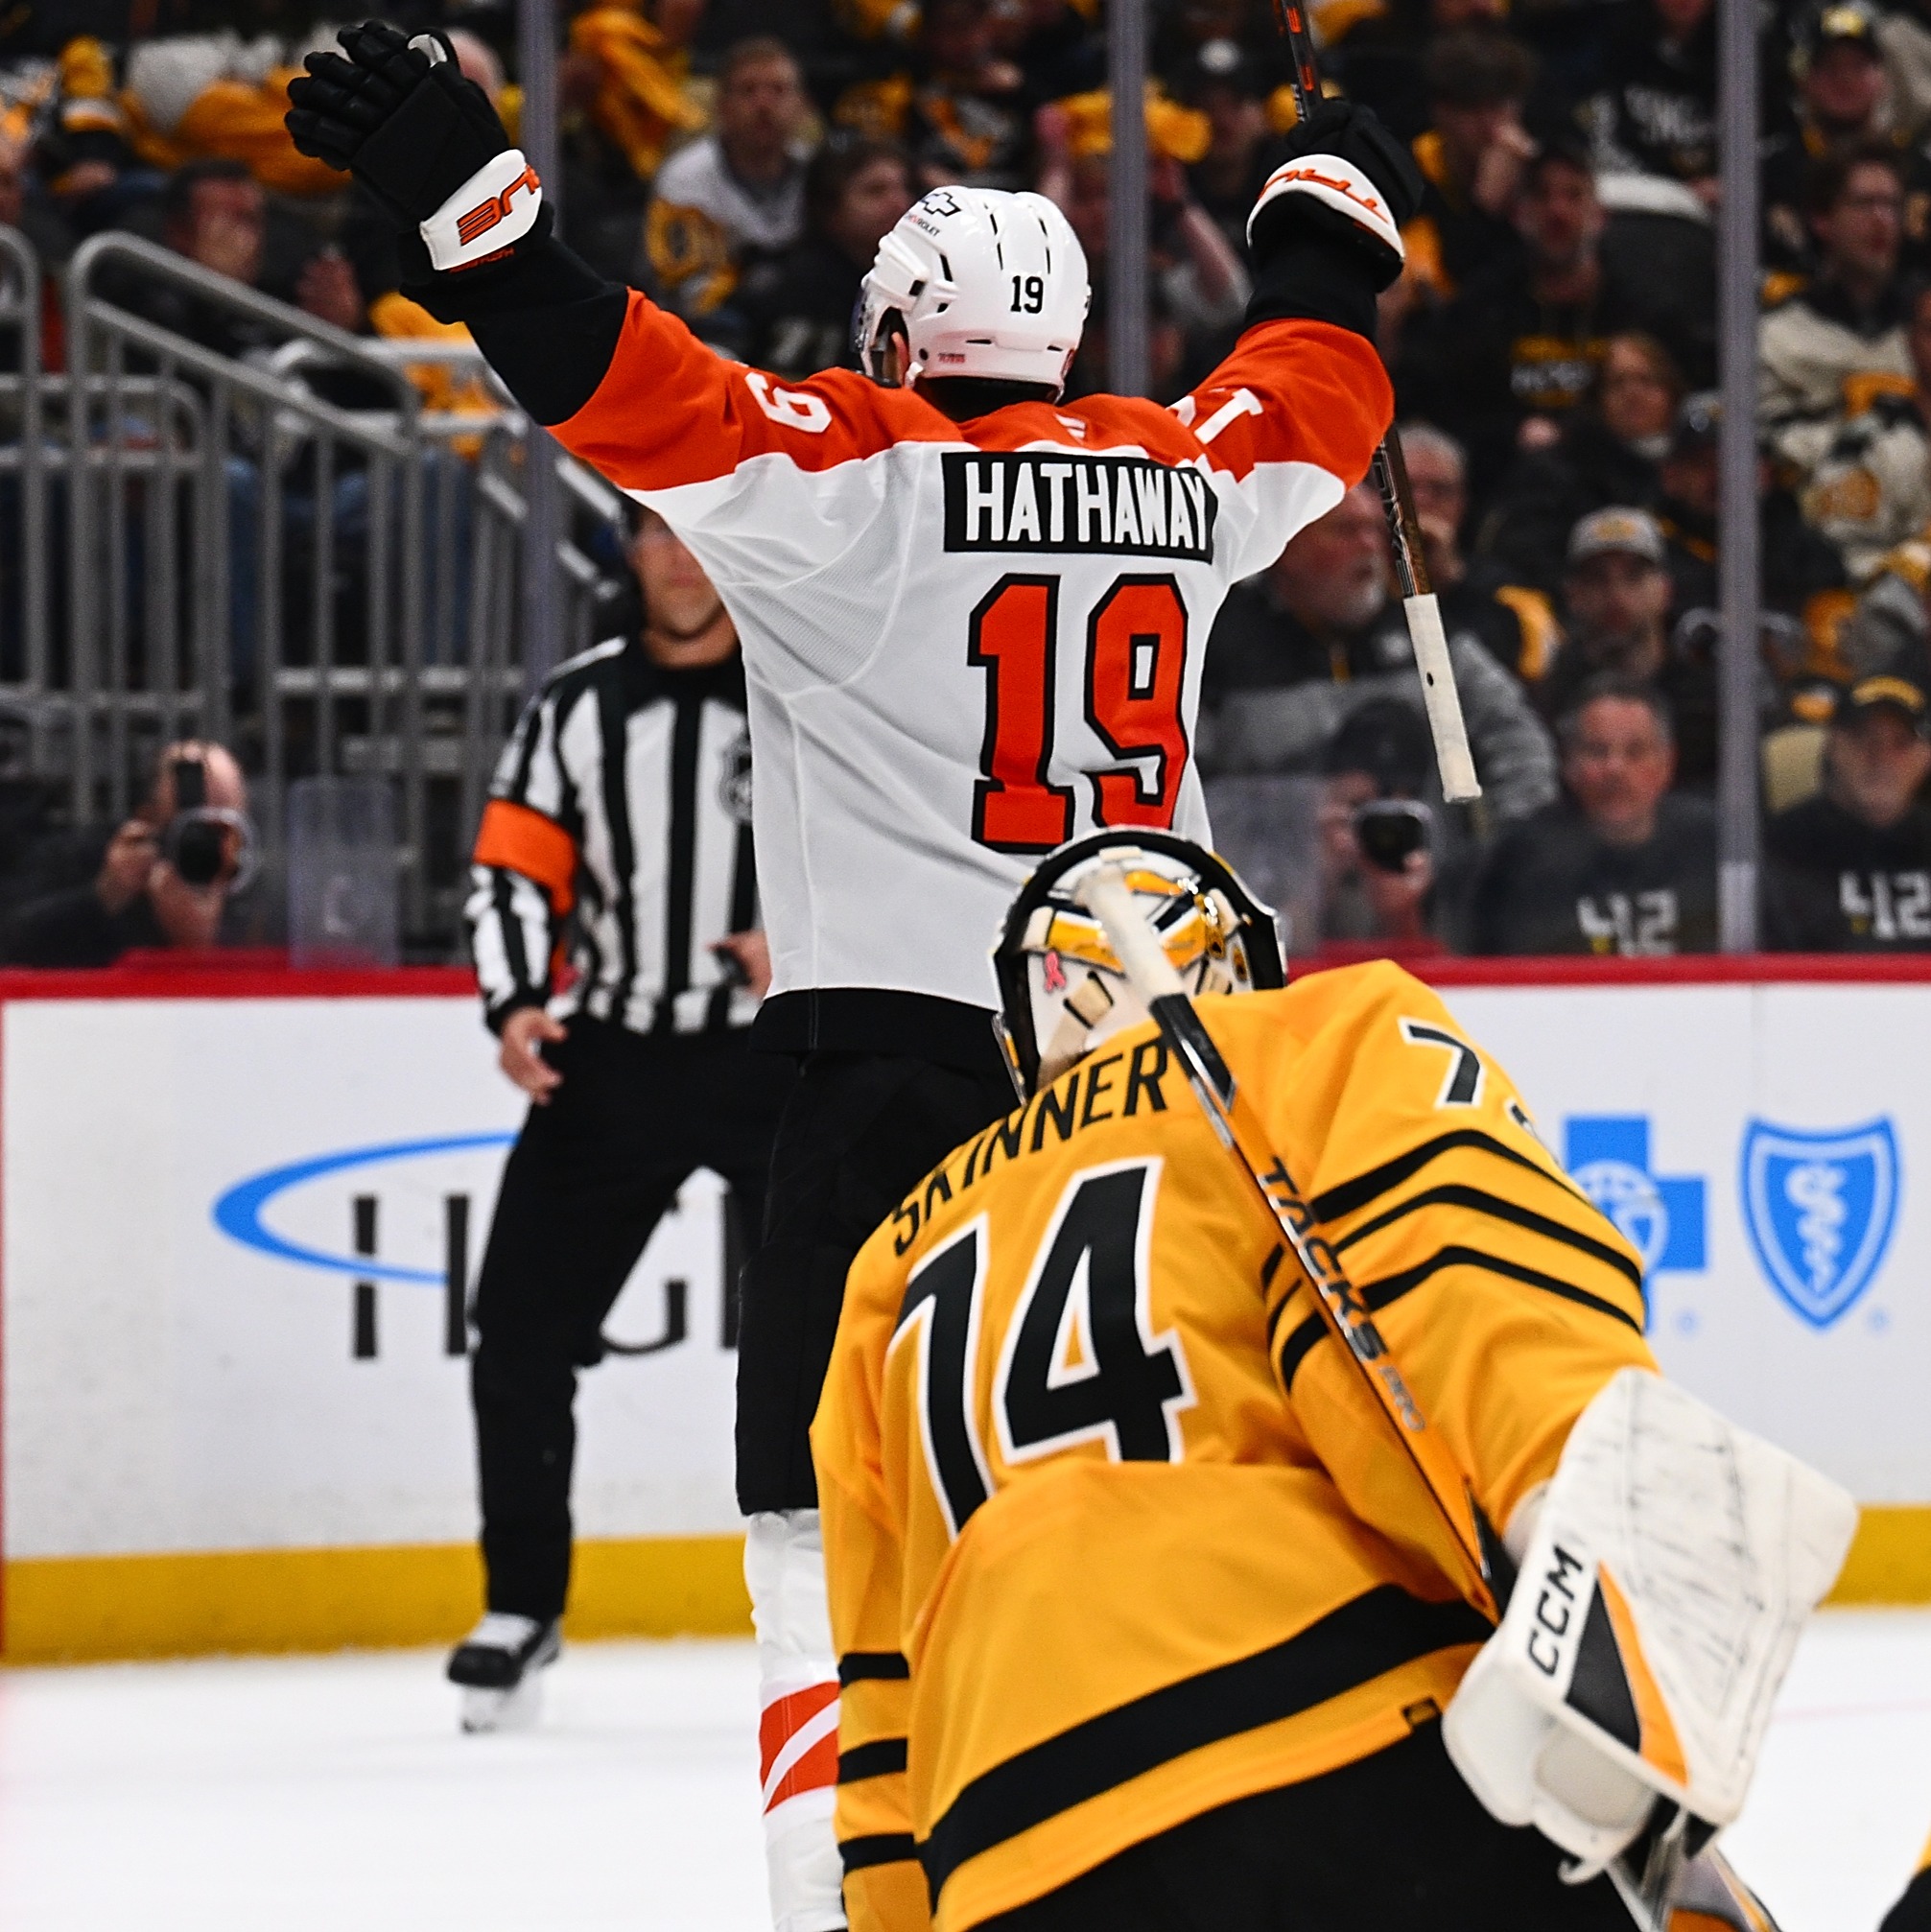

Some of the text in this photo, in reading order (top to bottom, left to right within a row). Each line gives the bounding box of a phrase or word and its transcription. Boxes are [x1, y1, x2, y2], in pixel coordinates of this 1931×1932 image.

[1010, 275, 1044, 315] 19
[744, 371, 833, 434] 9
[965, 461, 1207, 551] HATHAWAY
[967, 573, 1189, 854] 19
[1259, 1156, 1389, 1361] TACKS
[884, 1155, 1199, 1543] 74
[1528, 1543, 1584, 1677] CCM
